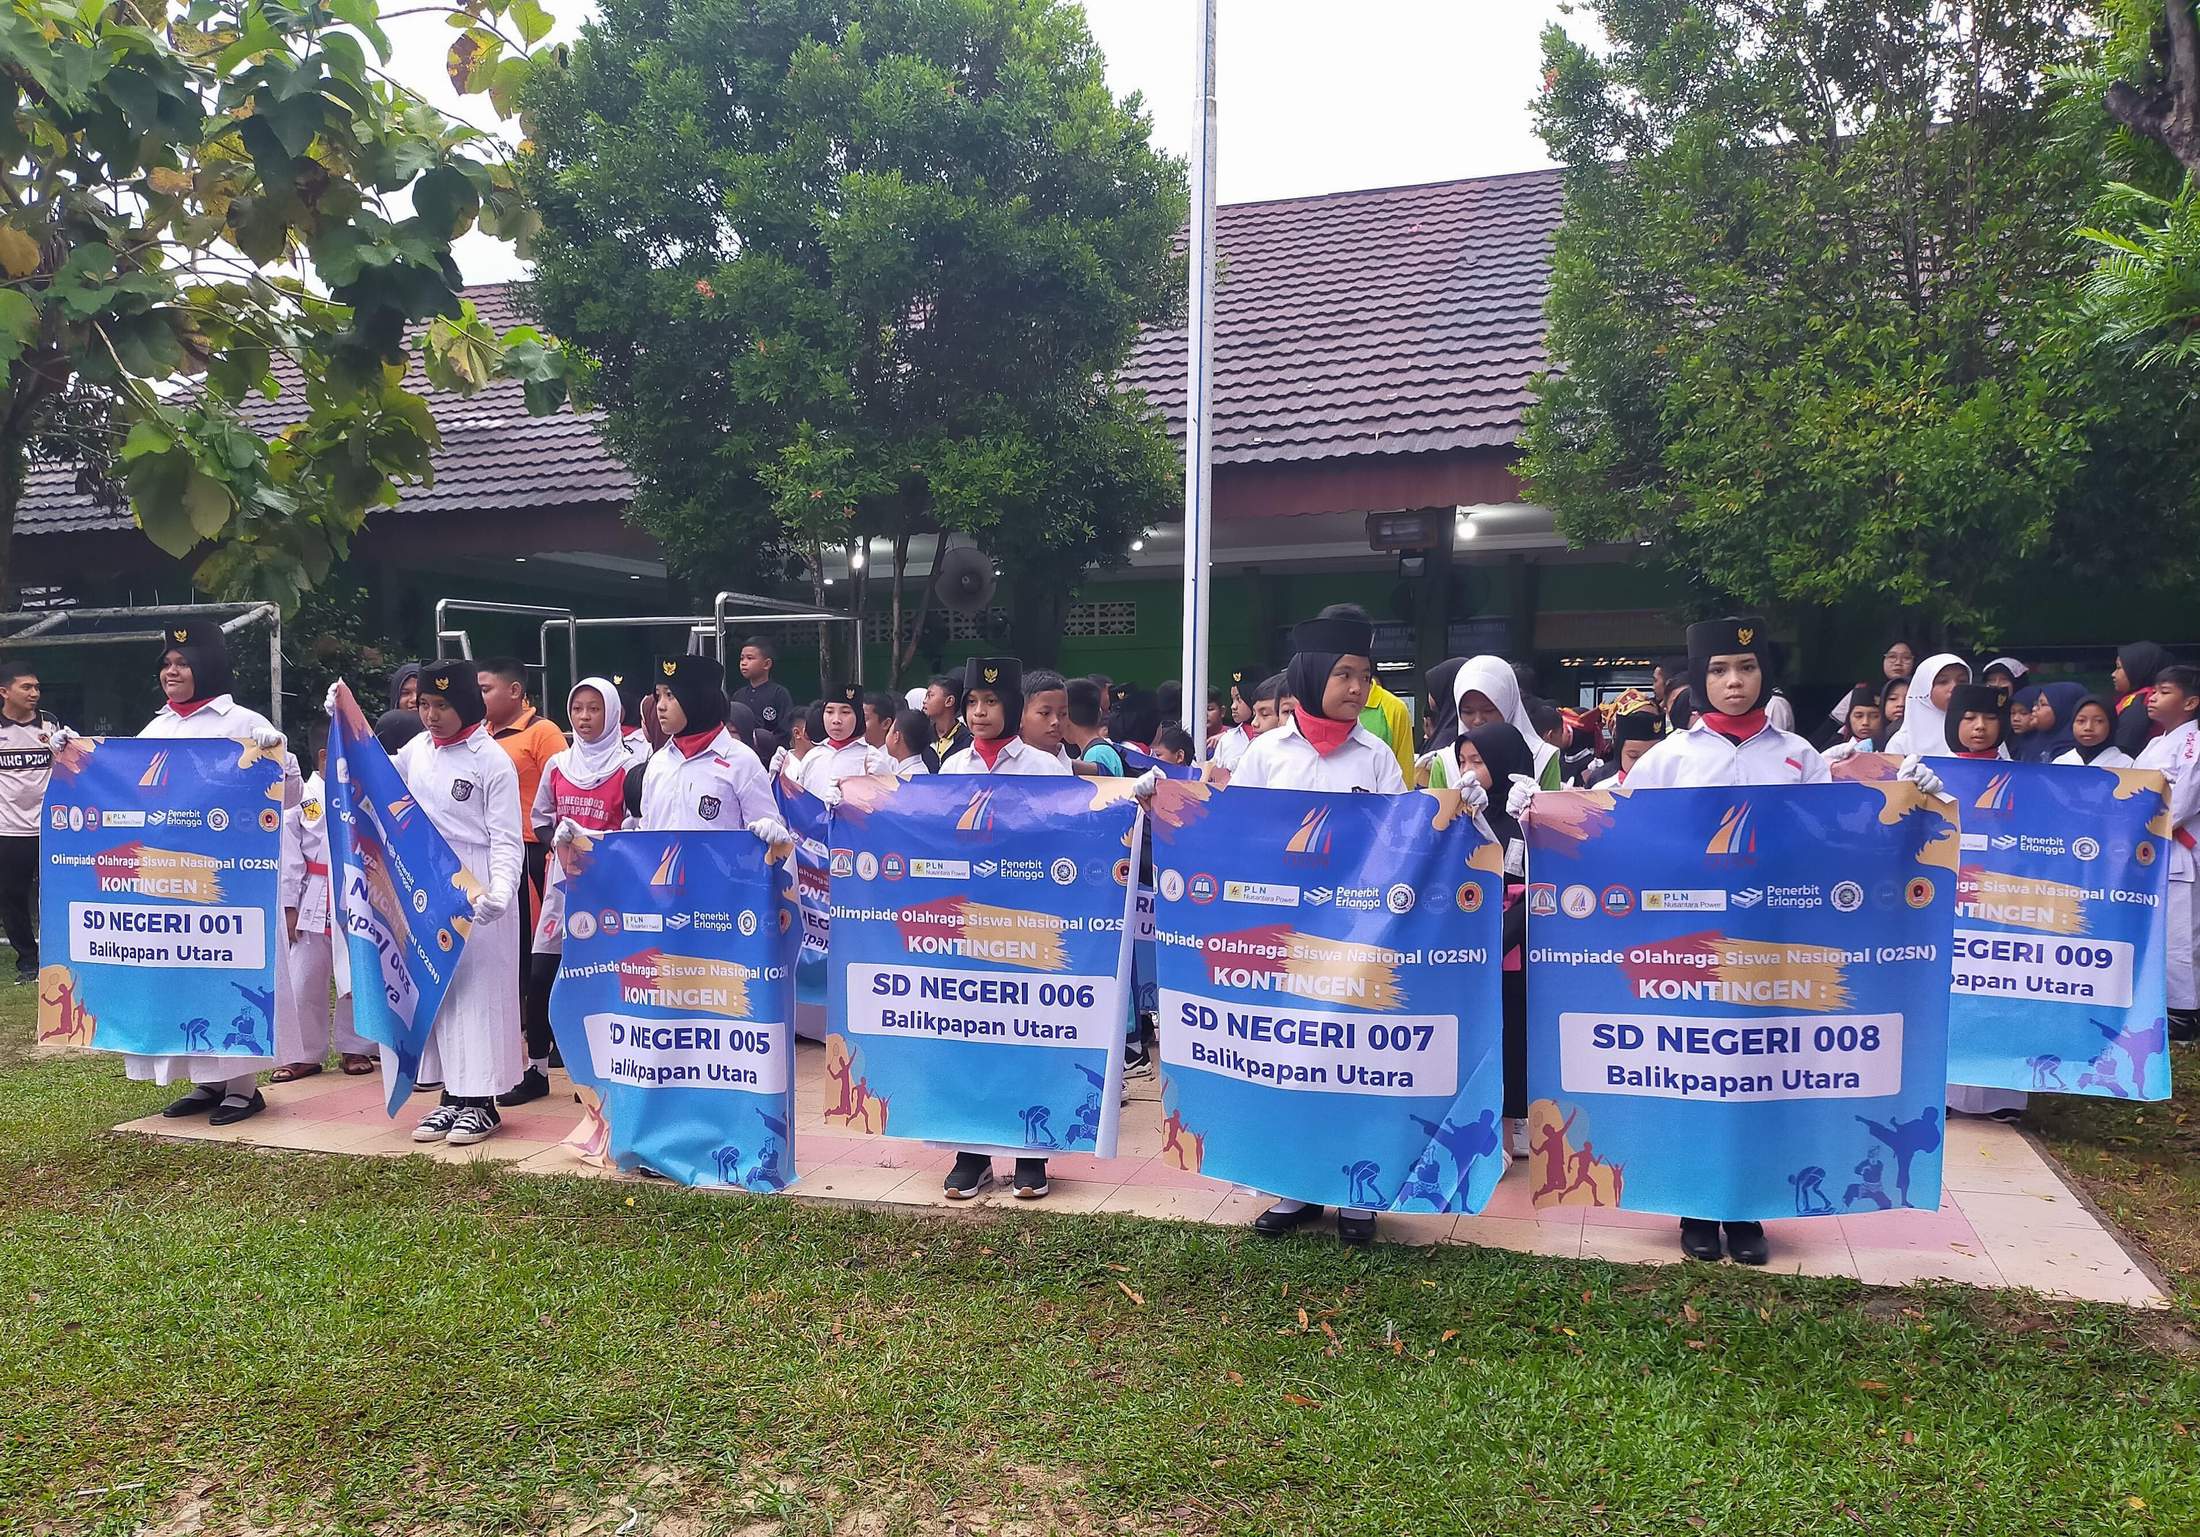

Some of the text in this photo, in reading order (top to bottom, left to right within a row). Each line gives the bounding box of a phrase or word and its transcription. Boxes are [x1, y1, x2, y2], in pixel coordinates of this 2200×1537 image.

[167, 809, 201, 818] Penerbit
[167, 817, 202, 827] Erlangga
[2020, 834, 2064, 846] Penerbit
[2020, 843, 2066, 856] Erlangga
[51, 853, 279, 871] Olimpiade Olahraga Siswa Nasional (O2SN
[926, 861, 944, 869] PLN
[1001, 859, 1043, 870] Penerbit
[101, 876, 197, 894] KONTINGEN
[1000, 868, 1045, 881] Erlangga
[1243, 885, 1267, 894] PLN
[1337, 886, 1380, 897] Penerbit
[1663, 893, 1689, 901] PLN
[1766, 884, 1820, 896] Penerbit
[1984, 880, 2030, 895] Siswa
[2035, 883, 2105, 901] Nasional
[2109, 889, 2160, 908] (O2SN)
[1335, 896, 1381, 910] Erlangga
[1663, 901, 1699, 909] Nusantara
[1766, 896, 1822, 909] Erlangga
[83, 910, 243, 934] SD NEGERI 001
[694, 911, 730, 921] Penerbit
[694, 920, 732, 932] Erlangga
[829, 905, 899, 922] Olimpiade
[901, 910, 965, 928] Olahraga
[968, 913, 1012, 928] Siswa
[1017, 915, 1084, 931] Nasional
[1088, 917, 1125, 932] (O2S
[89, 941, 233, 963] Balikpapan Utara
[907, 935, 1037, 960] KONTINGEN
[1155, 930, 1488, 966] mpiade Olahraga Siswa Nasional (O2SN)
[1529, 944, 1937, 968] Olimpiade Olahraga Siswa Nasional (O2SN)
[1953, 937, 2114, 969] EGERI 009
[560, 960, 620, 980] limpiade
[621, 962, 658, 978] Oahraga
[662, 965, 705, 976] Siswa
[710, 965, 760, 980] Nasional
[872, 972, 1095, 1008] SD NEGERI 006
[1213, 966, 1366, 998] KONTINGEN
[1639, 978, 1812, 1001] KONTINGEN
[2025, 975, 2095, 998] Utara
[624, 986, 727, 1007] KONTINGEN
[881, 1009, 1078, 1040] Balikpapan Utara
[1181, 1002, 1435, 1052] SD NEGERI 007
[610, 1022, 771, 1055] D NEGERI 005
[1592, 1023, 1881, 1055] SD NEGERI 008
[707, 1063, 758, 1085] Utara
[1191, 1042, 1414, 1088] Balikpapan Utara
[1606, 1064, 1861, 1097] Balikpapan Utara
